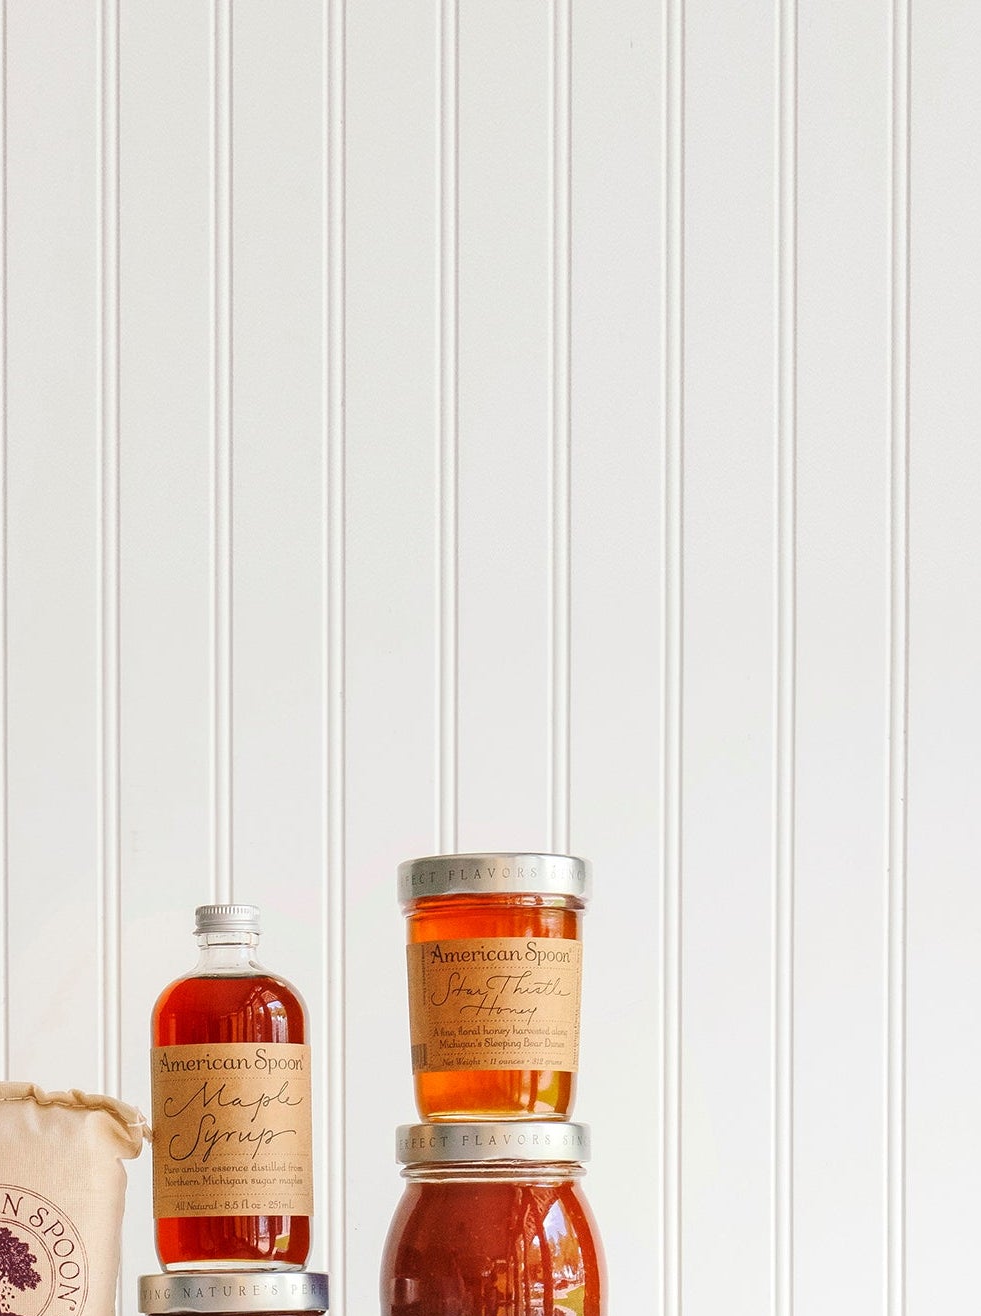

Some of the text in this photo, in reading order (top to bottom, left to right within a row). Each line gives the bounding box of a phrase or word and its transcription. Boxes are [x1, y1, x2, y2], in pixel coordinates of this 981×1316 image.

[431, 943, 522, 964] American
[460, 994, 538, 1026] Honey
[160, 1053, 254, 1074] American
[164, 1081, 302, 1122] Maple
[169, 1114, 297, 1162] Syrup
[462, 1135, 551, 1147] FLAVORS
[202, 1175, 248, 1188] Michigan
[28, 1207, 81, 1303] SPOON
[183, 1284, 279, 1299] NATURE'S
